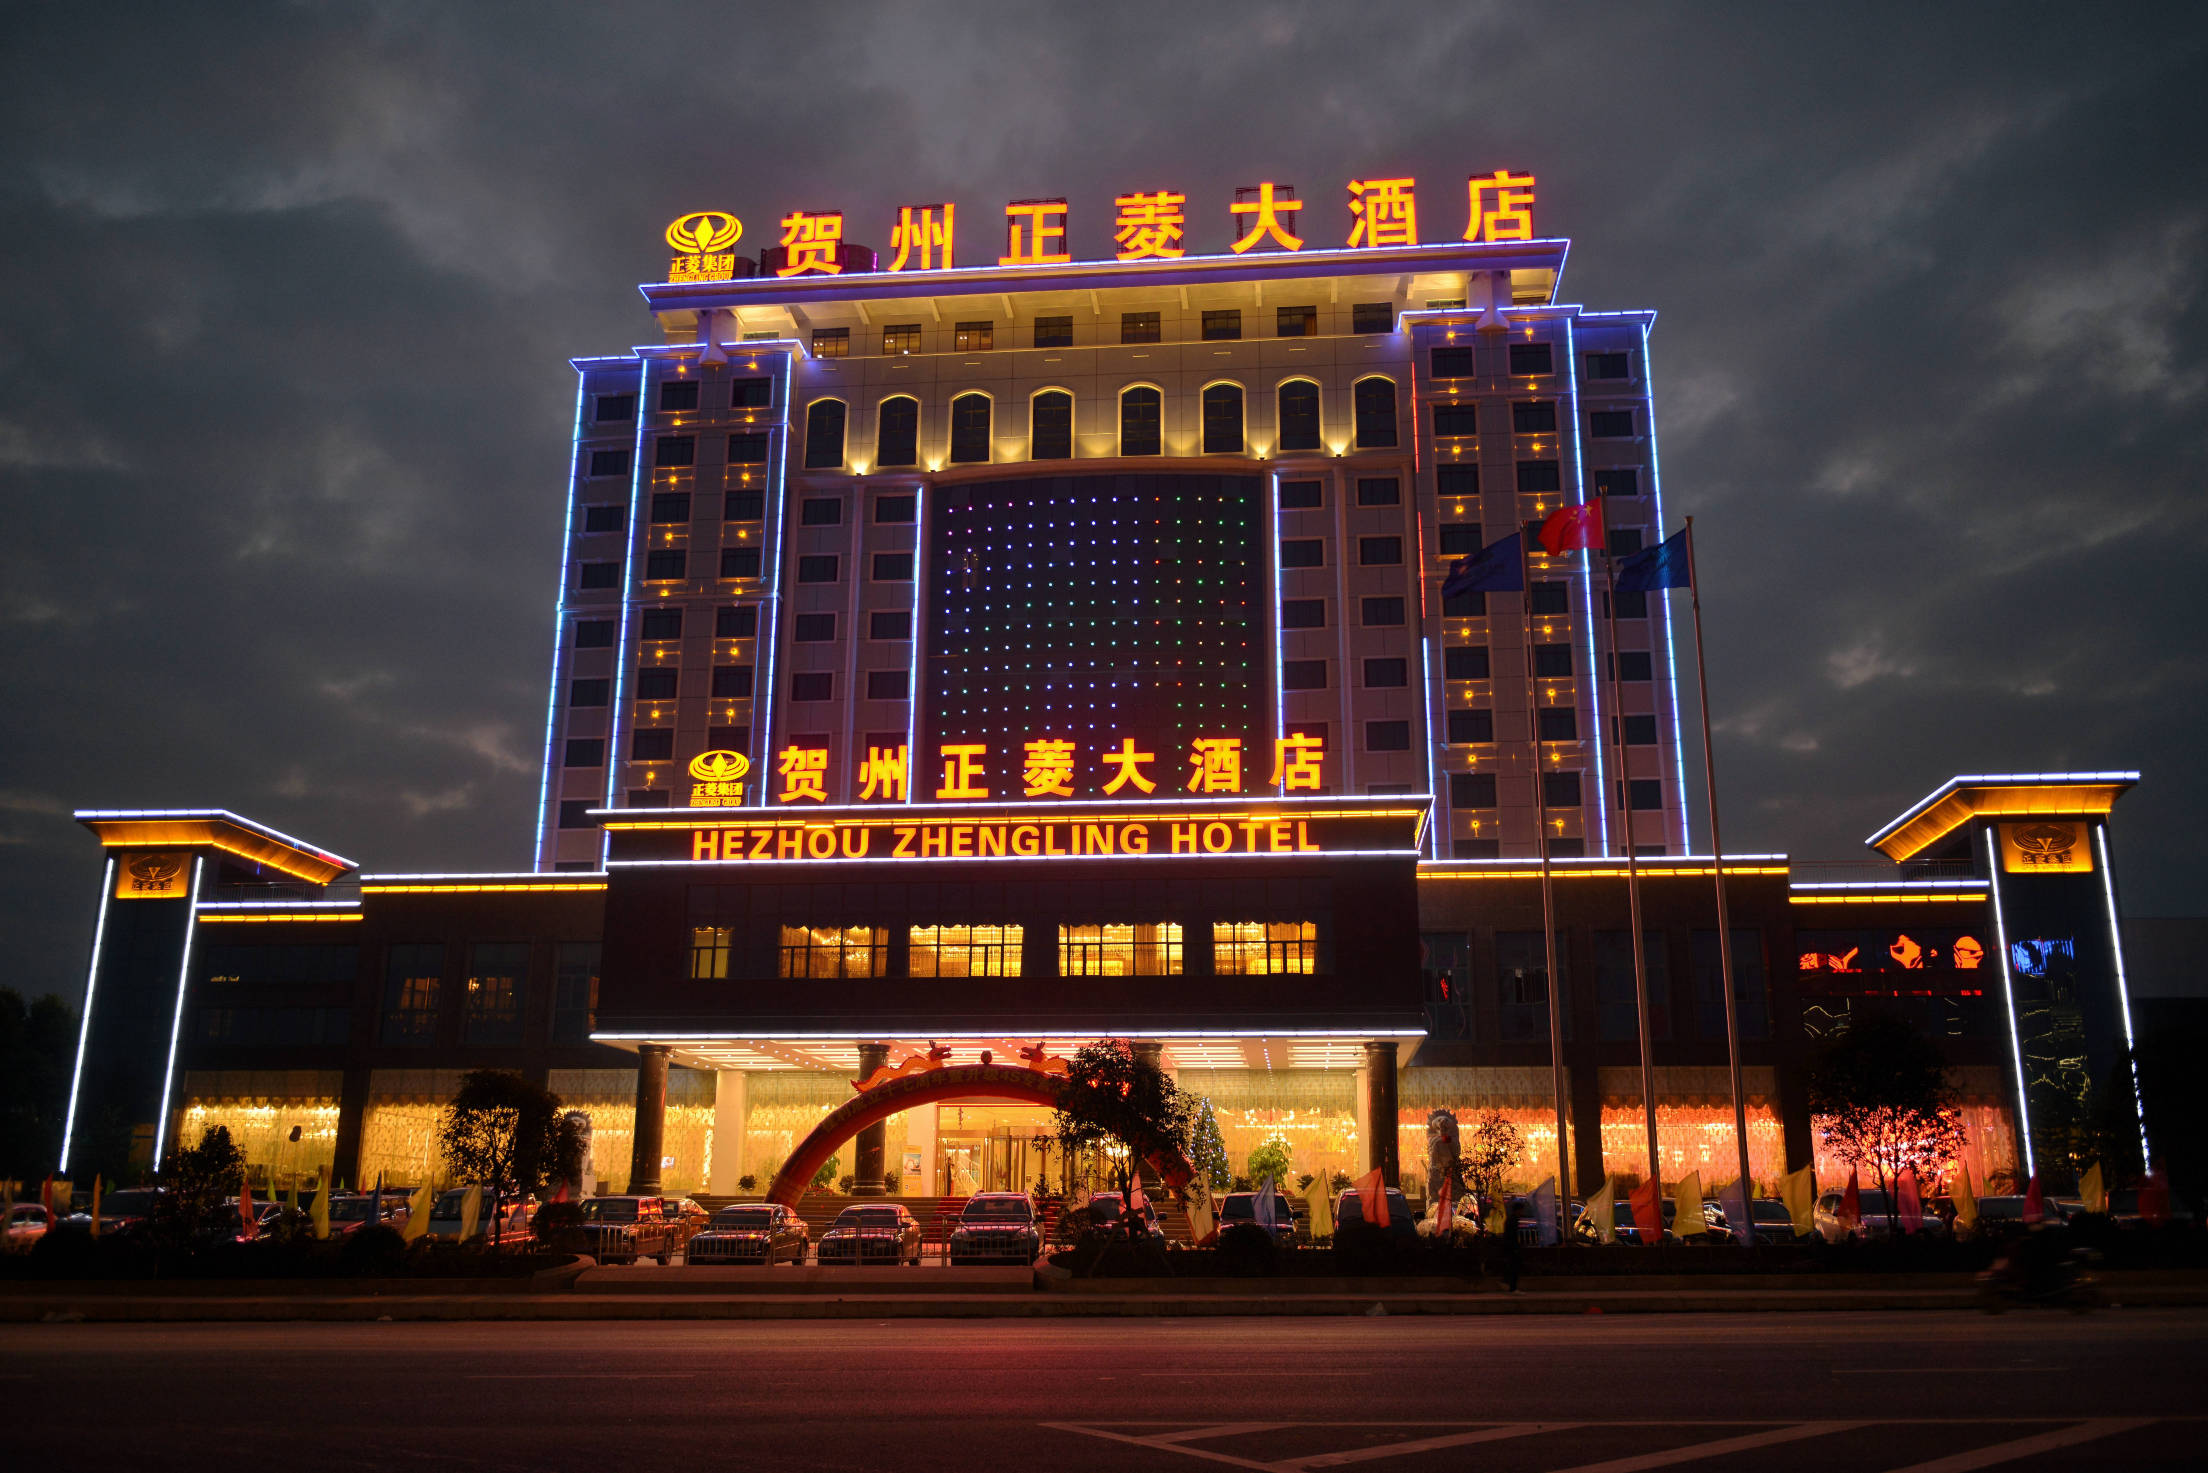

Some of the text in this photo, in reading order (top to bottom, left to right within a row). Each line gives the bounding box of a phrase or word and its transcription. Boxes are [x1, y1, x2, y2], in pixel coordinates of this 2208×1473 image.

[775, 168, 1537, 279] 贺州正菱大酒店
[671, 254, 735, 274] 正菱集团
[777, 732, 1324, 803] 贺州正菱大酒店
[691, 782, 743, 797] 正菱集团
[691, 821, 1321, 861] HEZHOU ZHENGLING HOTEL
